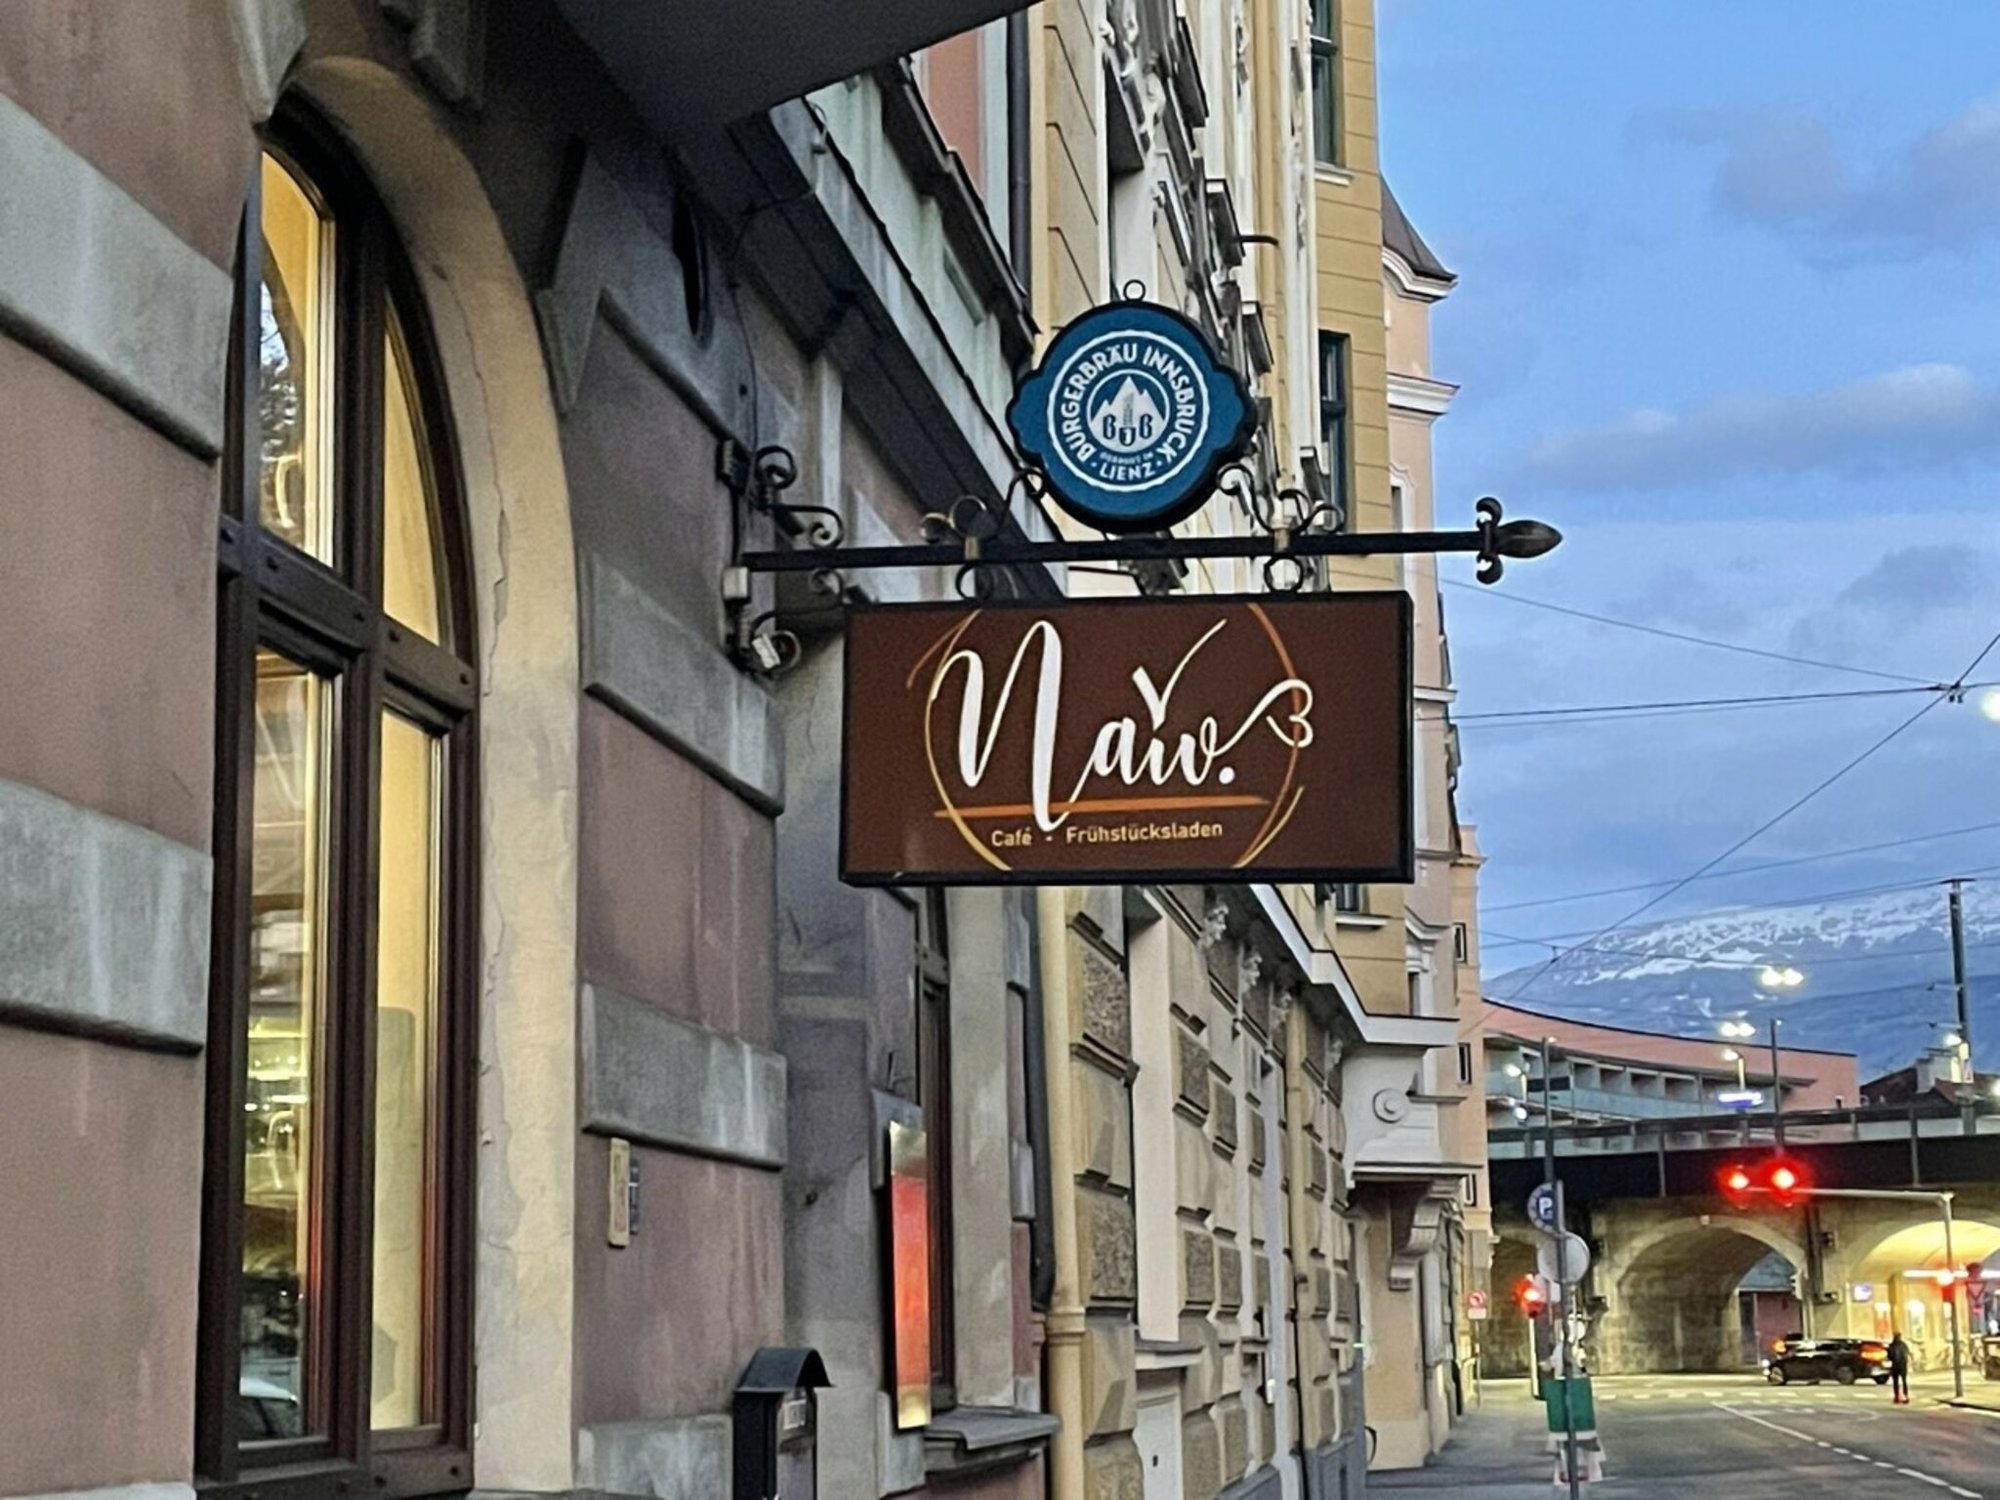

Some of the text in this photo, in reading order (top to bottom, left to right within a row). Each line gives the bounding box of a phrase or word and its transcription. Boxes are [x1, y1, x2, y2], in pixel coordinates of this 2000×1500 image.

[1142, 345, 1197, 463] INNSBRUCK
[1100, 461, 1156, 481] LIENZ
[991, 827, 1032, 847] Café
[1066, 821, 1223, 844] Frühstücksladen
